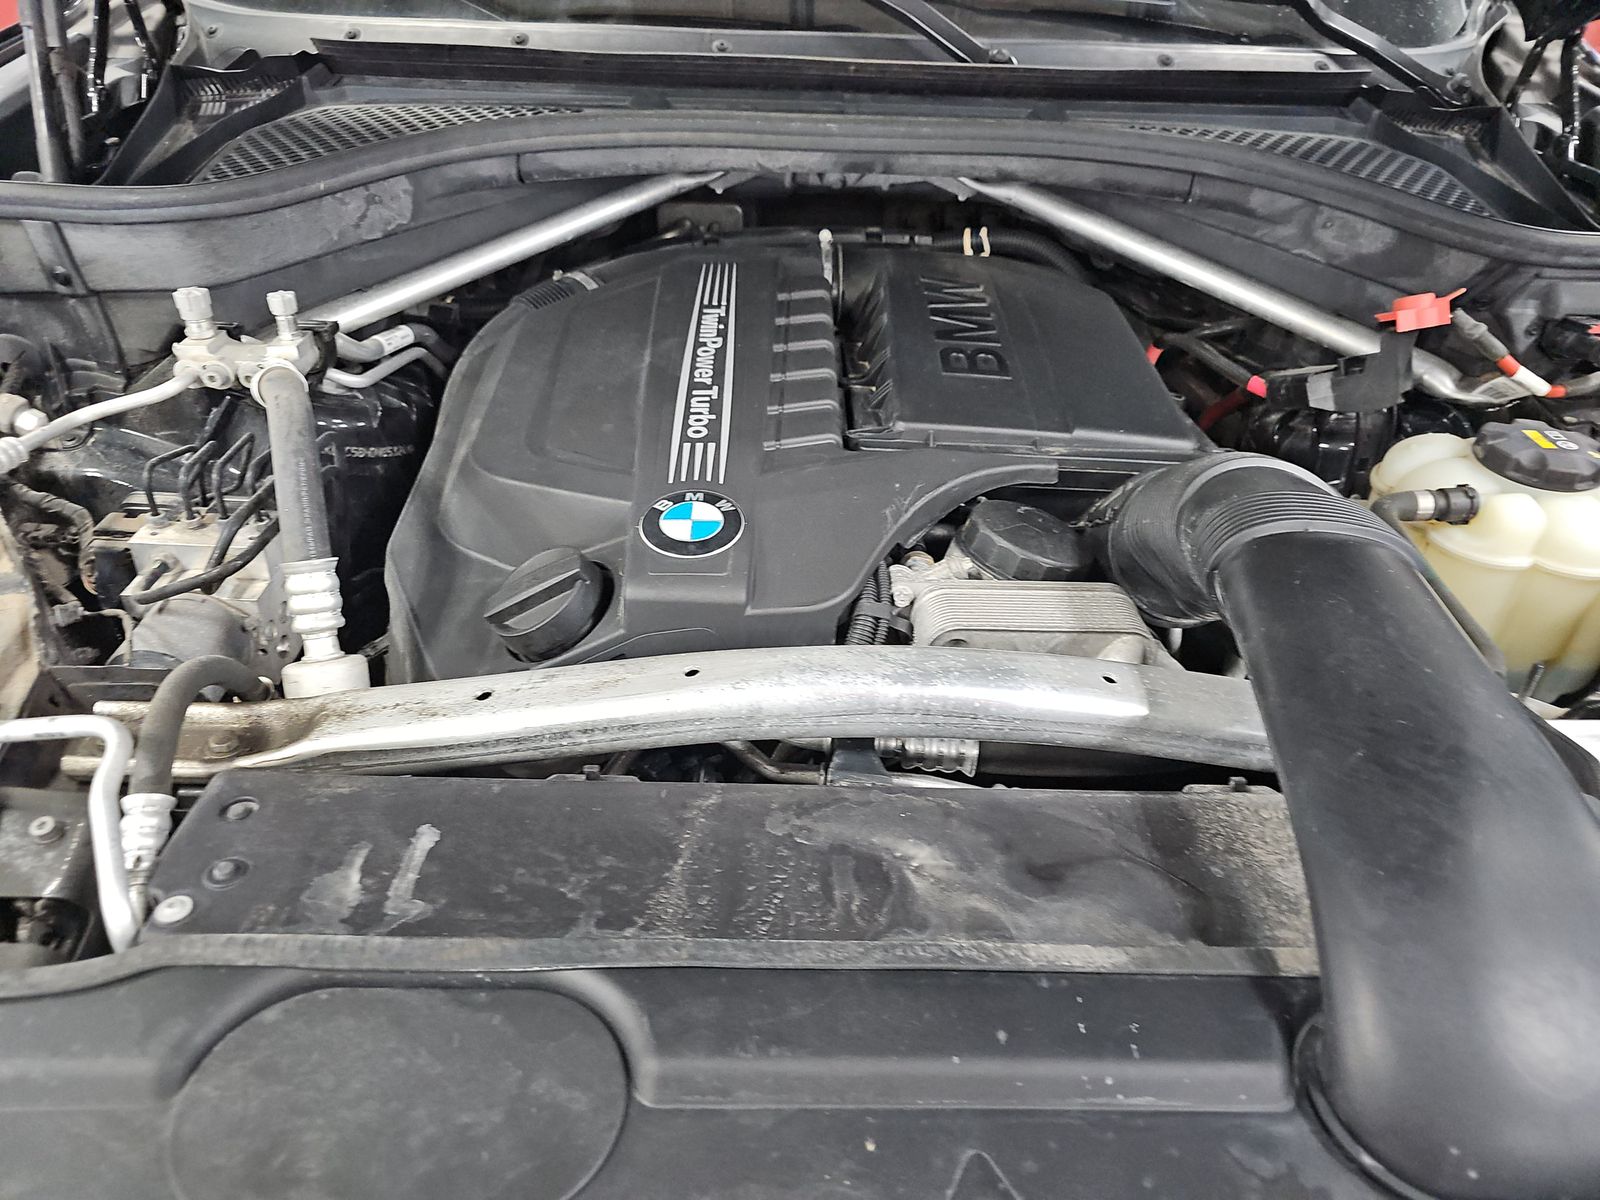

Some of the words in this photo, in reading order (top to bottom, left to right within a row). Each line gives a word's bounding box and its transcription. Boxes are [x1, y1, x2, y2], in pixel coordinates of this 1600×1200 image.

[693, 305, 726, 385] TwinPower
[920, 275, 1012, 379] BMW
[686, 385, 719, 439] Turbo
[652, 492, 737, 512] BMW
